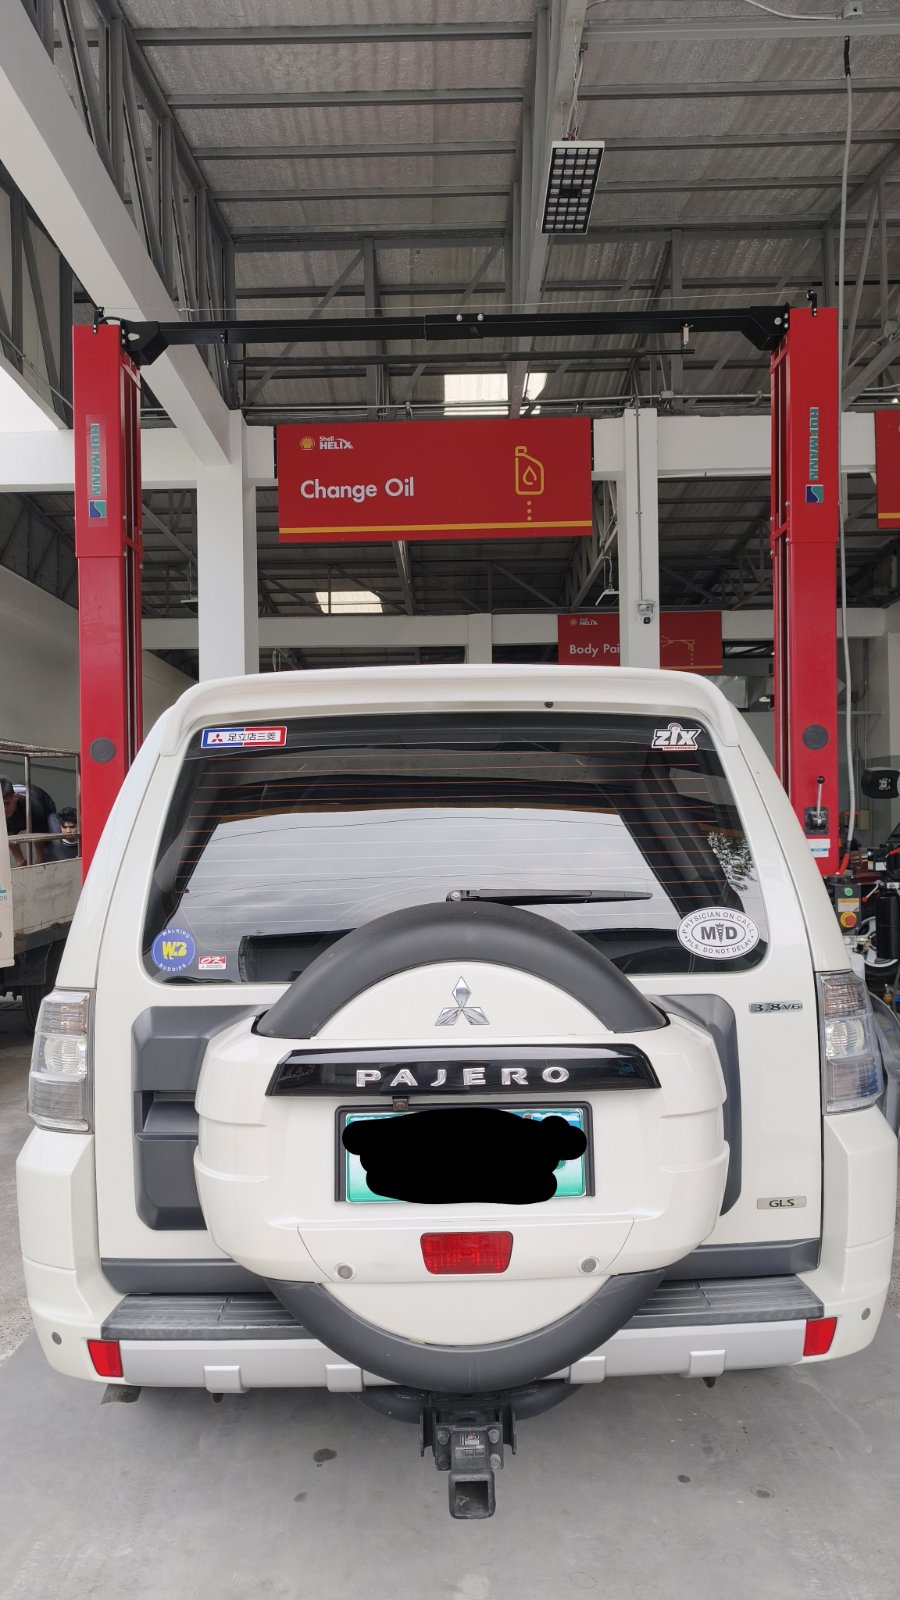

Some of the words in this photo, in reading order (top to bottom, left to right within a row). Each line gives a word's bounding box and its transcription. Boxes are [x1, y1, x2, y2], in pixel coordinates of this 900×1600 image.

[319, 438, 353, 450] HELIX
[300, 479, 378, 503] Change
[384, 477, 414, 497] Oil
[569, 643, 599, 657] Body
[603, 644, 620, 653] Pai
[682, 911, 720, 935] PHYSICIAN
[722, 911, 735, 920] ON
[736, 915, 755, 934] CALL
[162, 928, 191, 939] WALKING
[700, 926, 738, 940] MD
[686, 938, 701, 951] PLS.
[702, 946, 714, 954] DO
[715, 947, 730, 955] NOT
[731, 938, 753, 954] DELAY
[158, 963, 187, 972] BUDDIES
[356, 1066, 570, 1087] PAJERO
[769, 1199, 795, 1208] GLS
